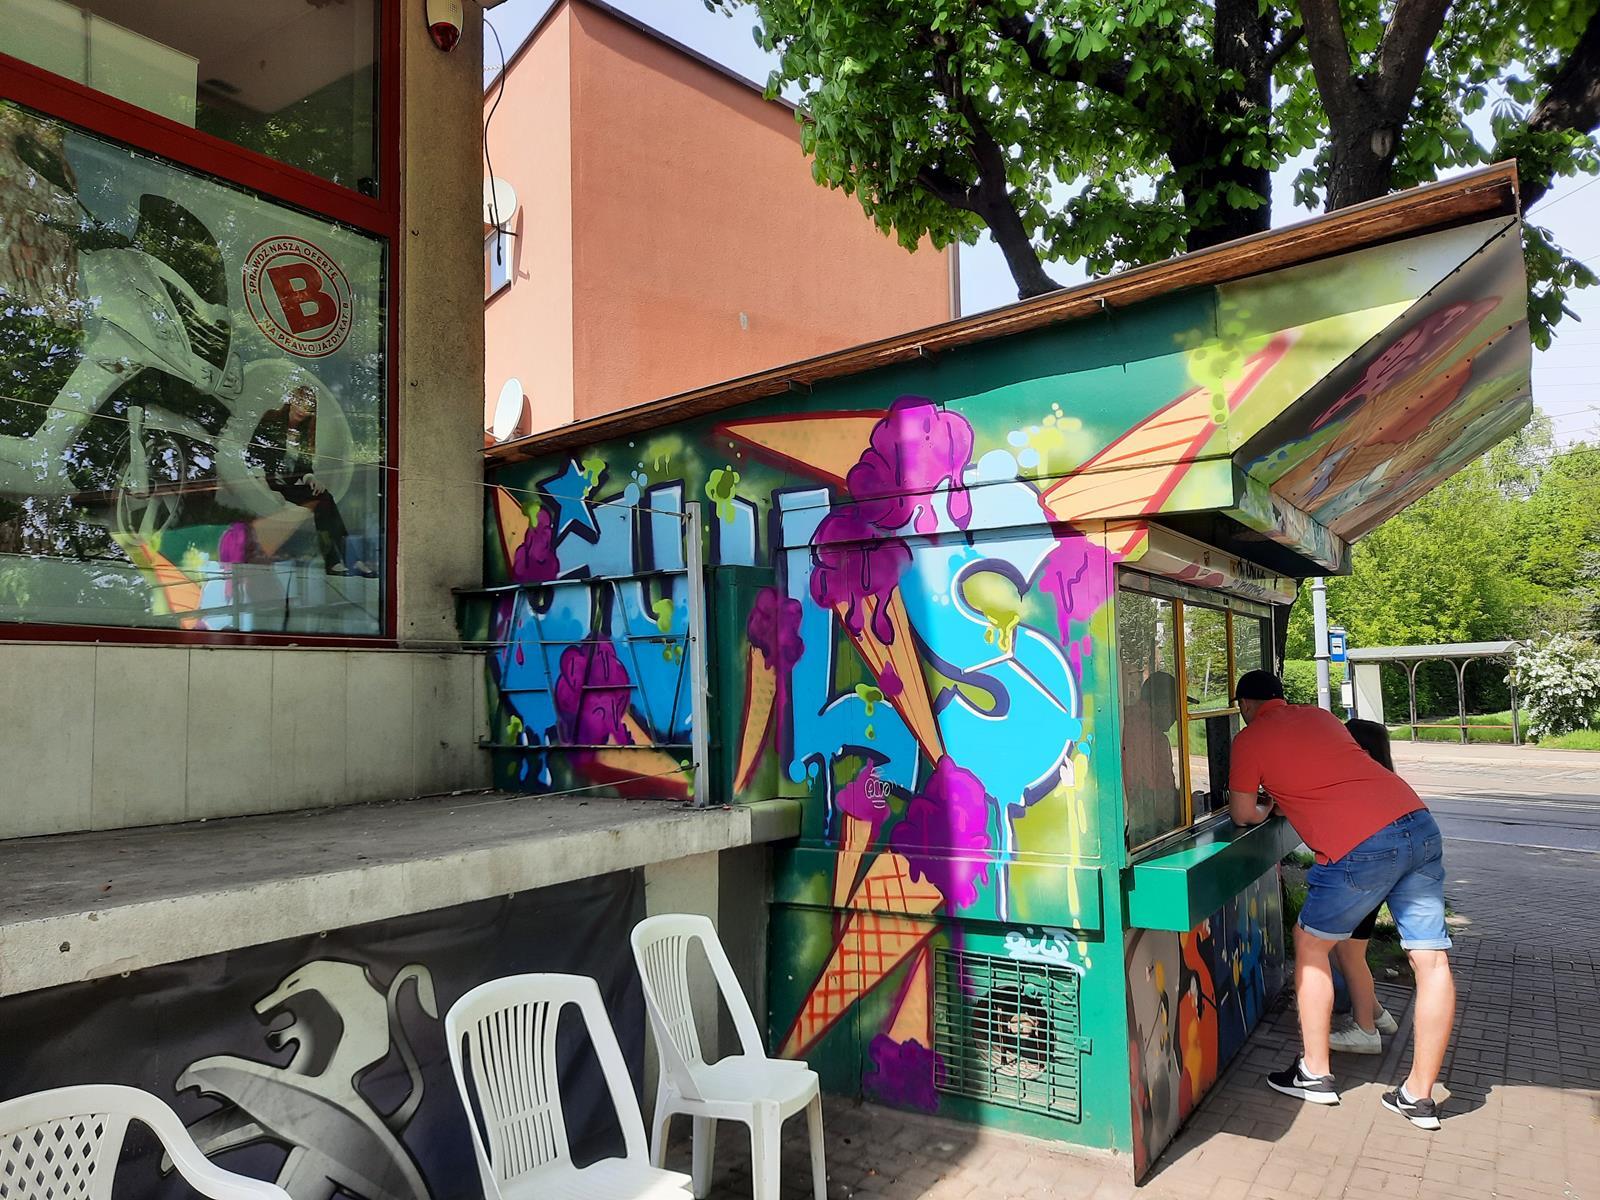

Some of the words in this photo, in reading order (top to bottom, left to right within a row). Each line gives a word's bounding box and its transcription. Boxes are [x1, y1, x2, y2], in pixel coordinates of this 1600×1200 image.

[266, 262, 338, 335] B
[263, 318, 276, 335] NA
[278, 334, 316, 352] PRAWO
[318, 332, 341, 352] JAZDY
